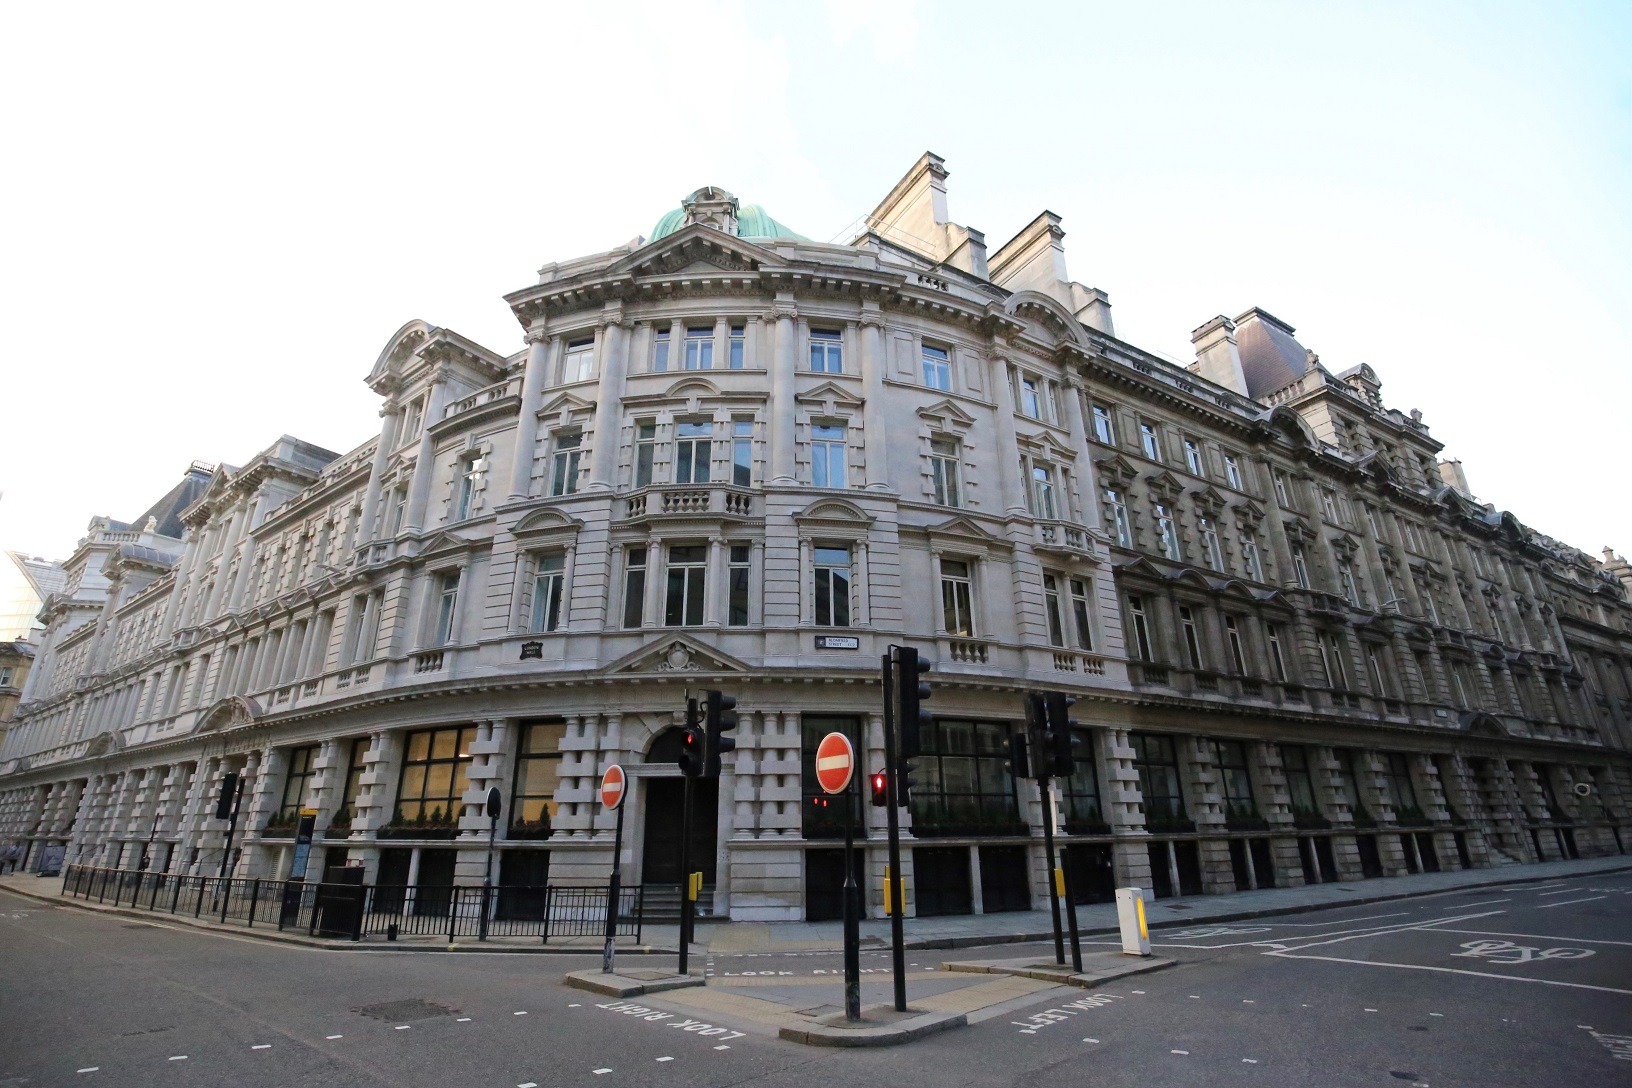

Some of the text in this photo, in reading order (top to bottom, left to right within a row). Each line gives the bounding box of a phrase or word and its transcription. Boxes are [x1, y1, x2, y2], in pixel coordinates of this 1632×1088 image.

[594, 1001, 747, 1041] LOOK RIGHT
[1011, 993, 1125, 1030] LOOK LEFT
